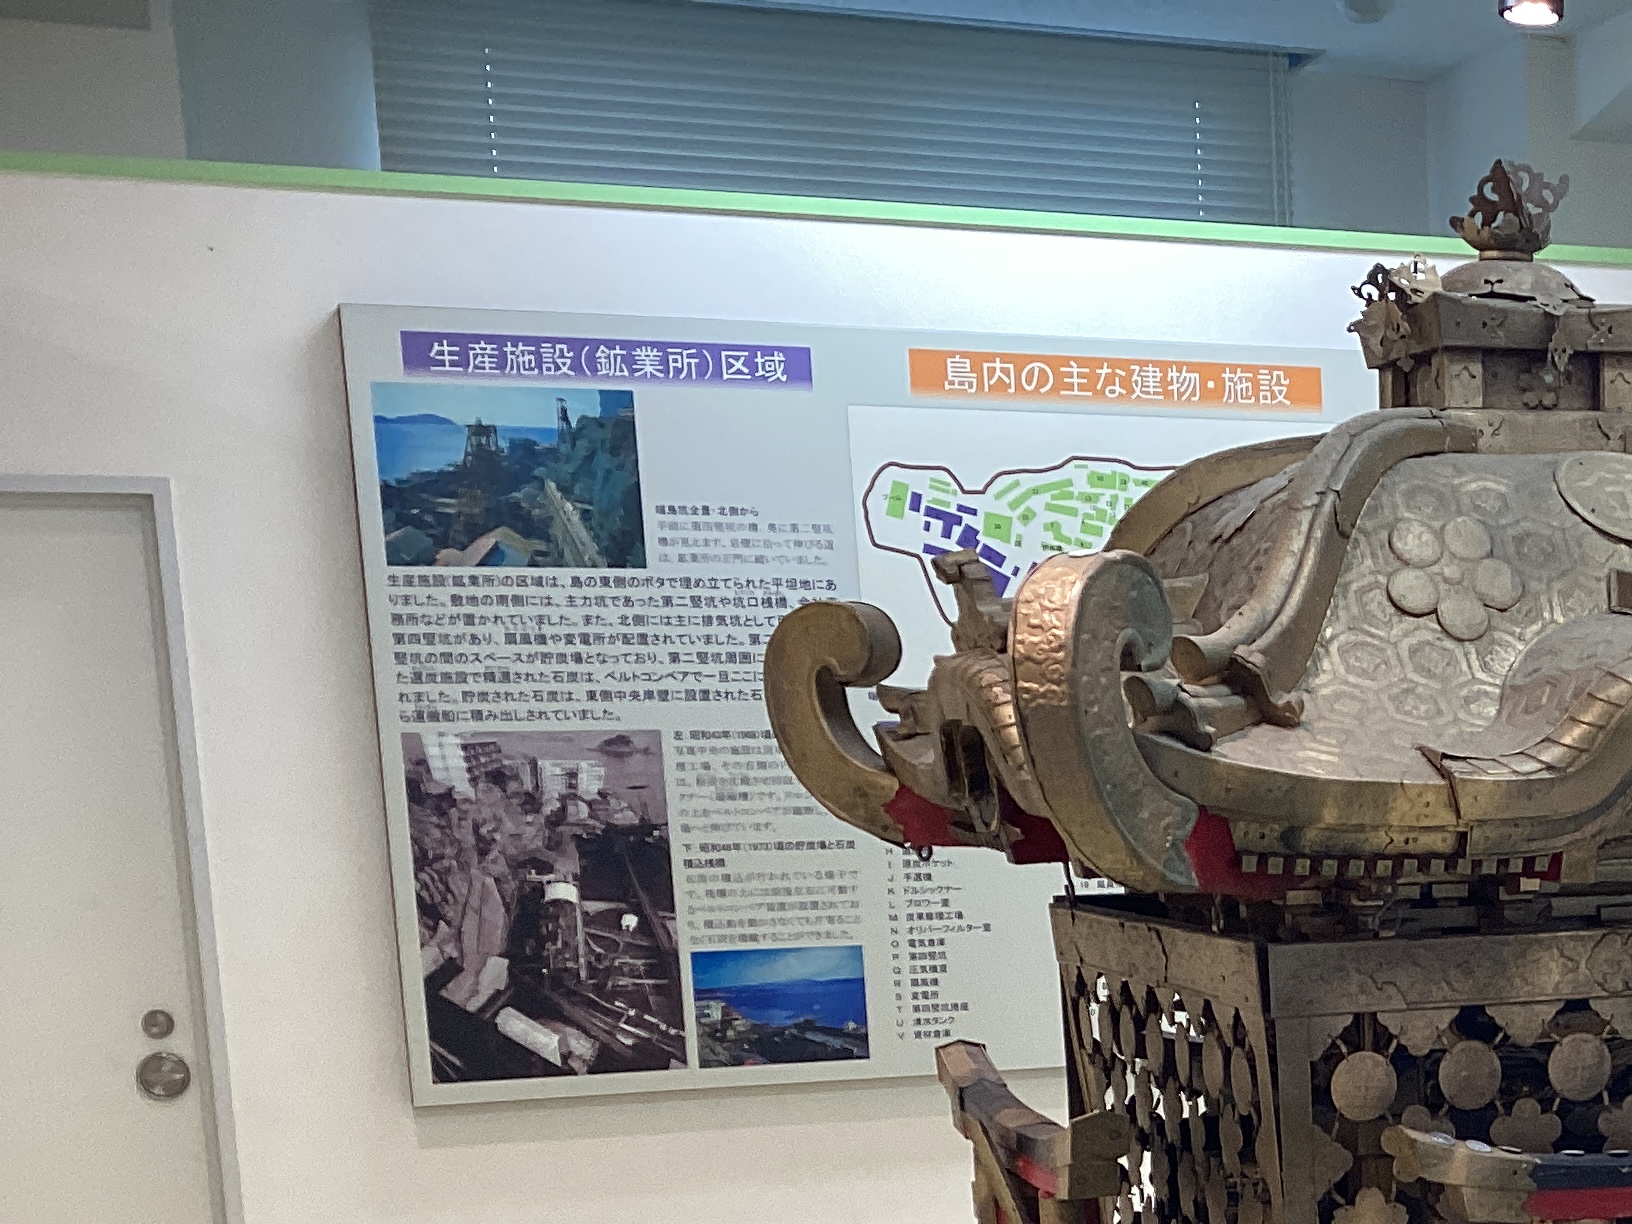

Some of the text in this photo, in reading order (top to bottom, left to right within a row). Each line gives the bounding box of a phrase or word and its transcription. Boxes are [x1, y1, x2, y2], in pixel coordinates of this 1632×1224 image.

[429, 338, 788, 383] 生産施設(鉱業所)区域
[943, 353, 1292, 406] 島内の主な建物・施設
